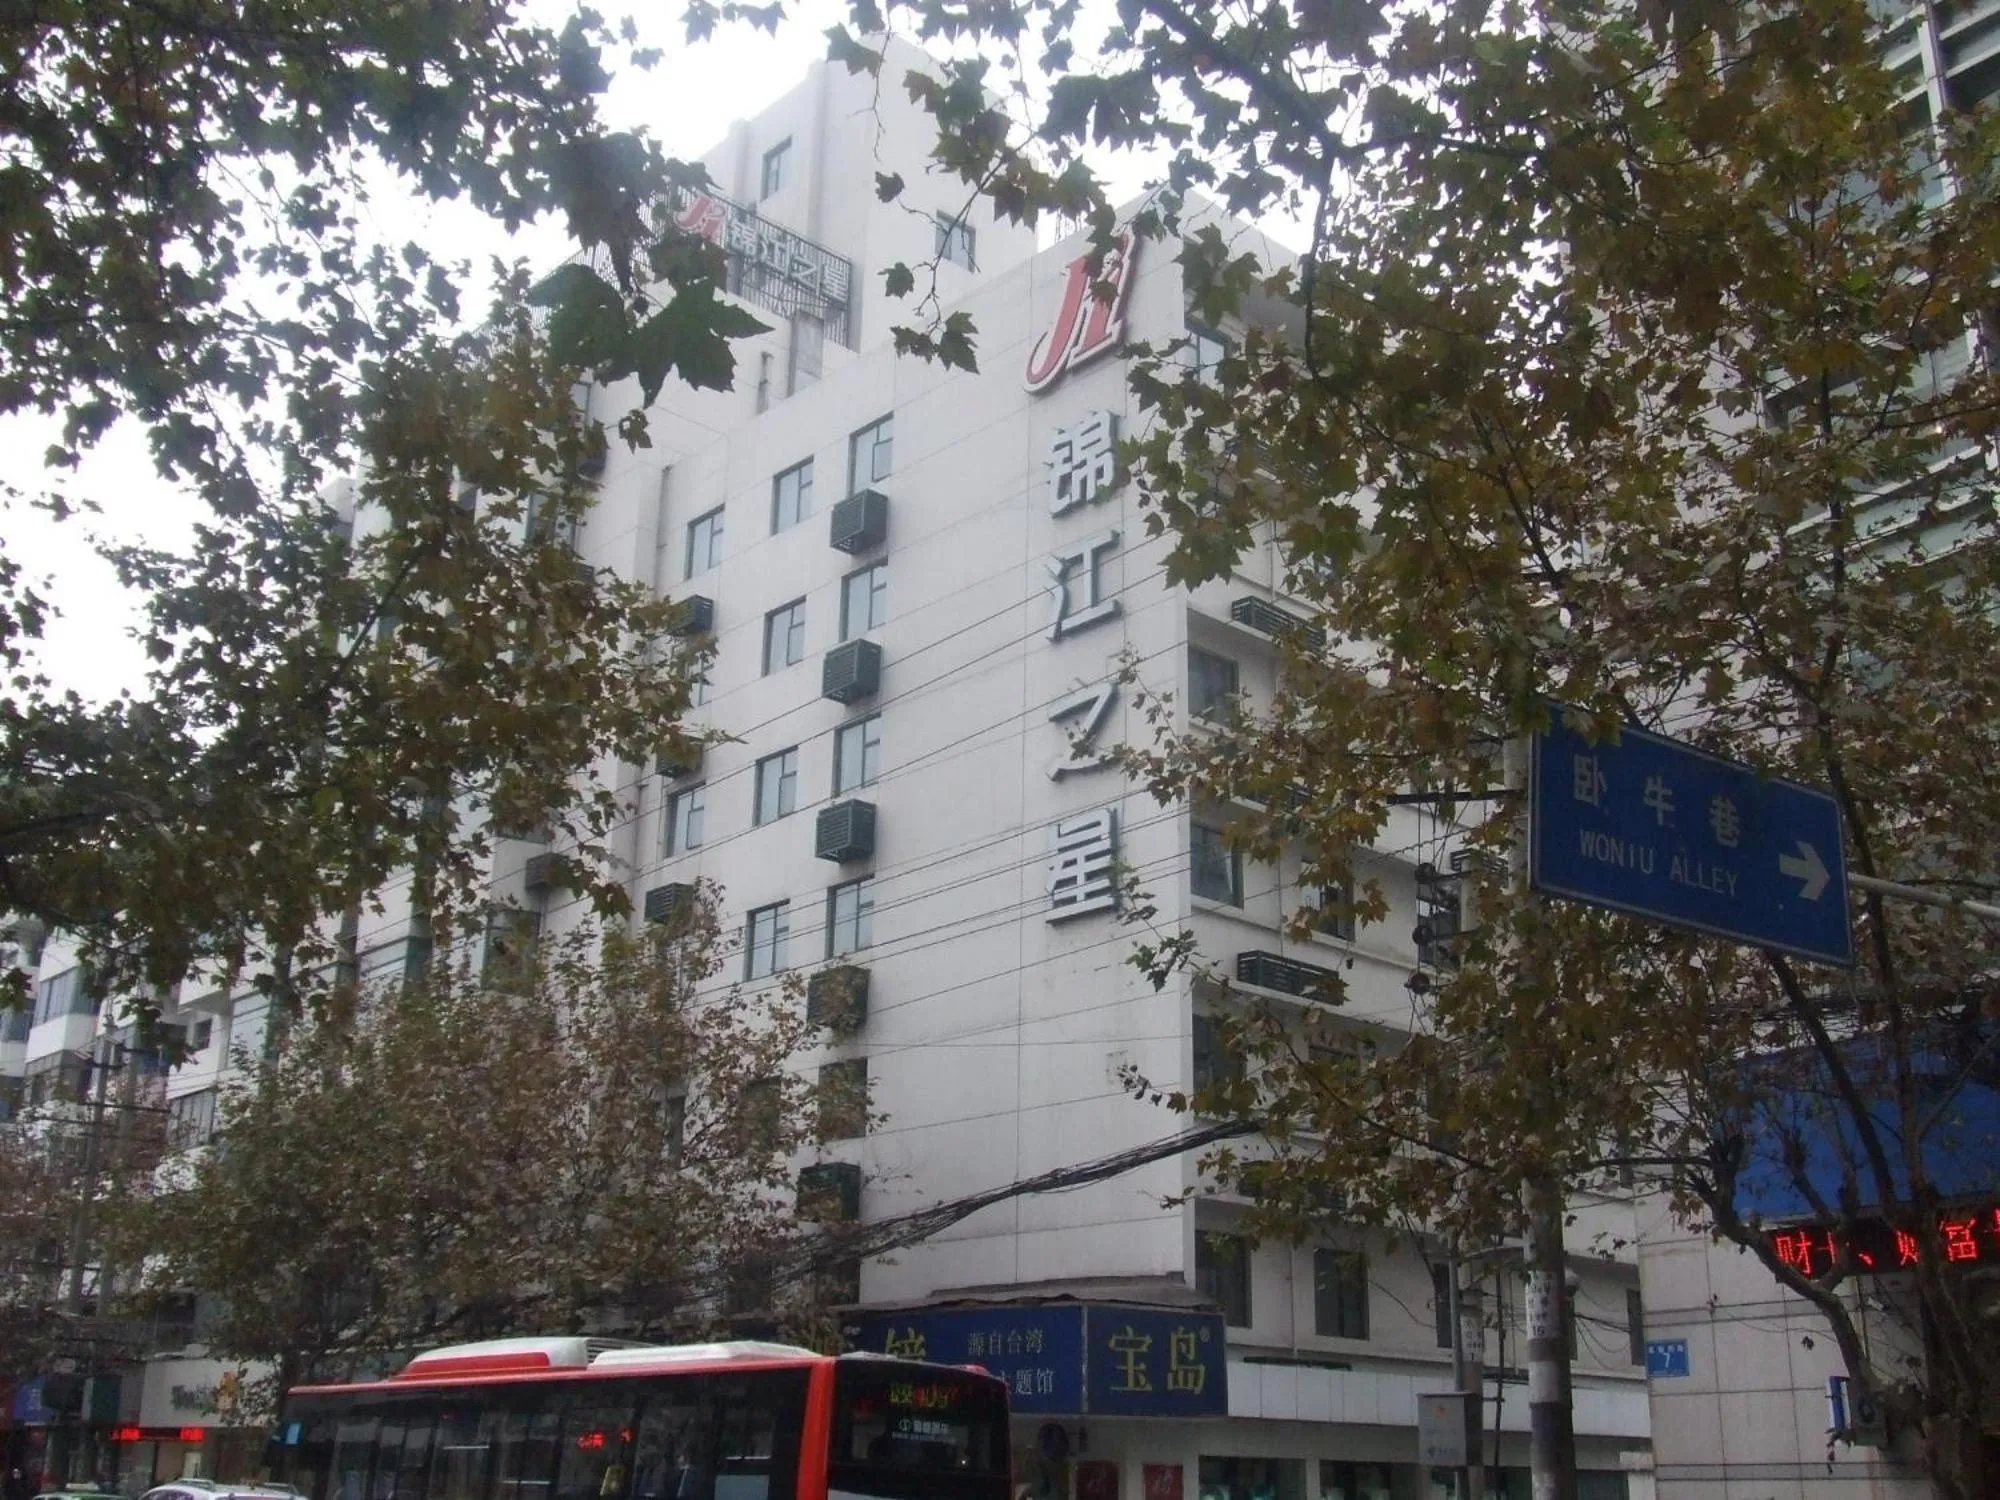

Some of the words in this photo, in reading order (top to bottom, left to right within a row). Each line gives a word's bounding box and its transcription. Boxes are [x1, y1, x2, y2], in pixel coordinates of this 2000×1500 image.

[1046, 408, 1121, 925] 锦江之星
[1574, 753, 1740, 848] 卧牛巷
[1579, 829, 1655, 875] WONIU
[1670, 855, 1739, 896] ALLEY
[967, 1328, 1043, 1357] 源自台湾
[1108, 1326, 1205, 1394] 宝岛
